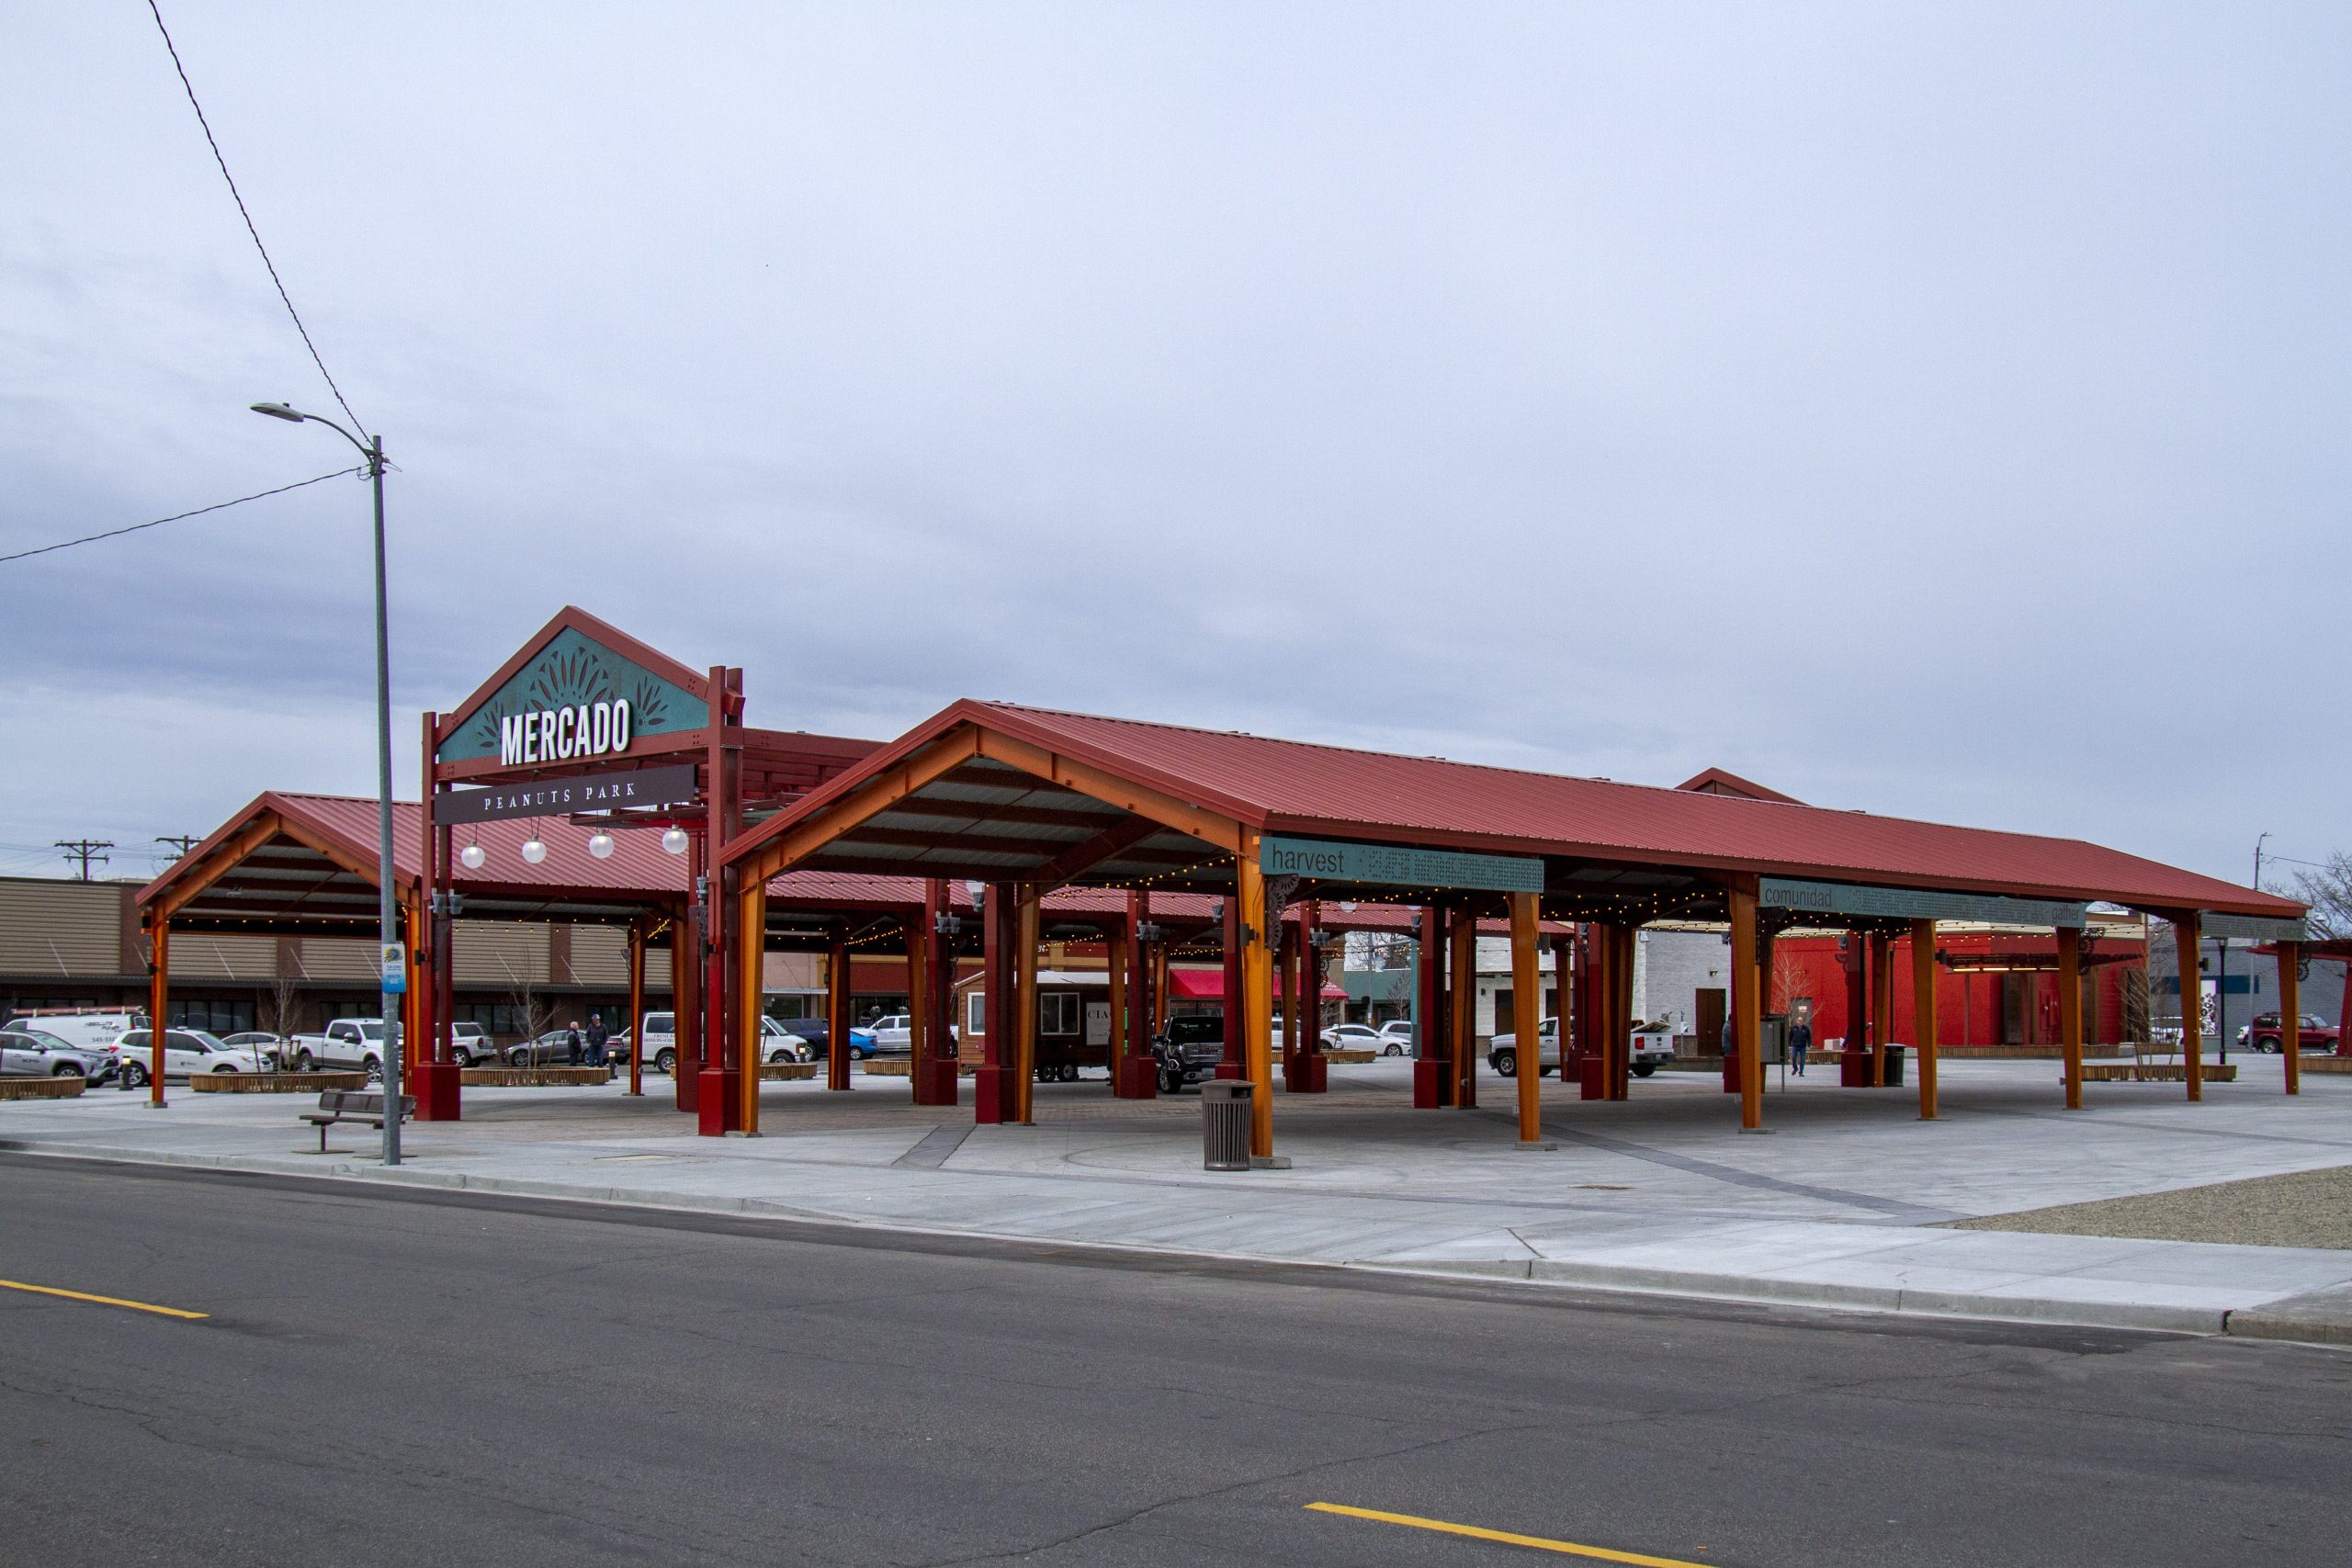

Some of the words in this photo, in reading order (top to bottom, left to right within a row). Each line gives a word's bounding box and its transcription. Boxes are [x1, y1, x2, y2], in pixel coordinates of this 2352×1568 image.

[501, 698, 631, 766] MERCADO
[484, 788, 571, 810] PEANUTS
[585, 783, 635, 800] PARK
[1272, 843, 1344, 874] harvest
[1765, 886, 1832, 908] comunidad
[2052, 904, 2080, 924] gather
[1087, 1010, 1109, 1019] CIA
